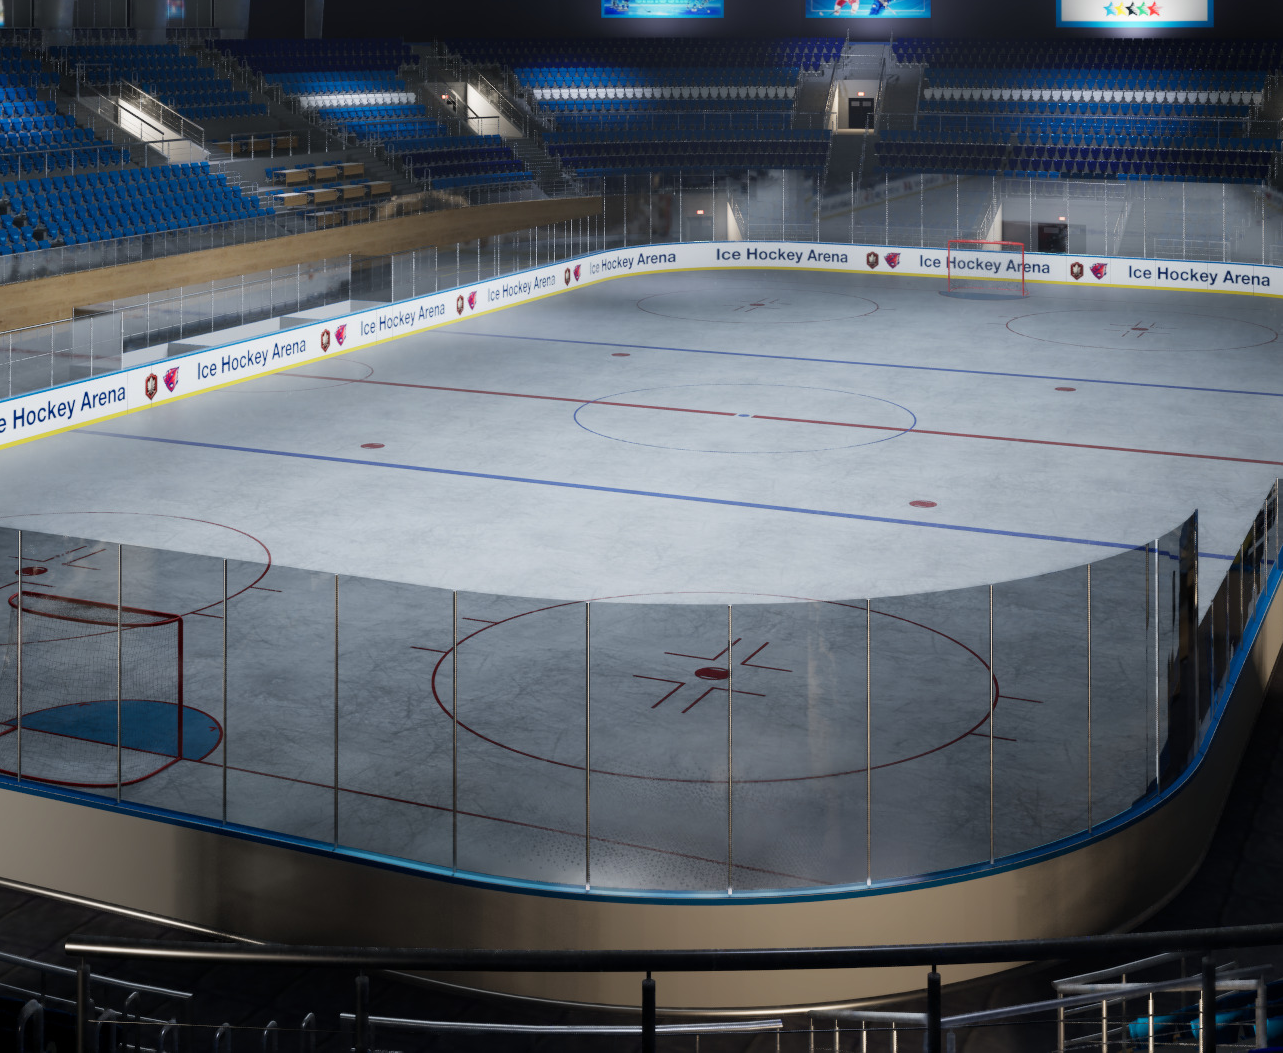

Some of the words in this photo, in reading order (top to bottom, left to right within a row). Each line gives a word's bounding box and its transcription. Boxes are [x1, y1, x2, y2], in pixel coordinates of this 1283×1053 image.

[601, 256, 634, 272] Hockey
[637, 253, 676, 266] Arena
[716, 248, 741, 261] Ice
[746, 248, 803, 264] Hockey
[807, 249, 848, 263] Arena
[919, 254, 941, 268] Ice
[946, 256, 1001, 274] Hockey
[1005, 259, 1050, 274] Arena
[487, 287, 500, 303] Ice
[502, 280, 532, 298] Hockey
[533, 274, 556, 290] Arena
[1128, 265, 1152, 279] Ice
[1157, 266, 1218, 285] Hockey
[1223, 270, 1270, 287] Arena
[360, 320, 376, 336] Ice
[379, 310, 416, 331] Hockey
[418, 303, 445, 321] Arena
[197, 362, 217, 380] Ice
[221, 349, 269, 374] Hockey
[271, 339, 306, 360] Arena
[13, 399, 76, 430] Hockey
[80, 386, 126, 412] Arena
